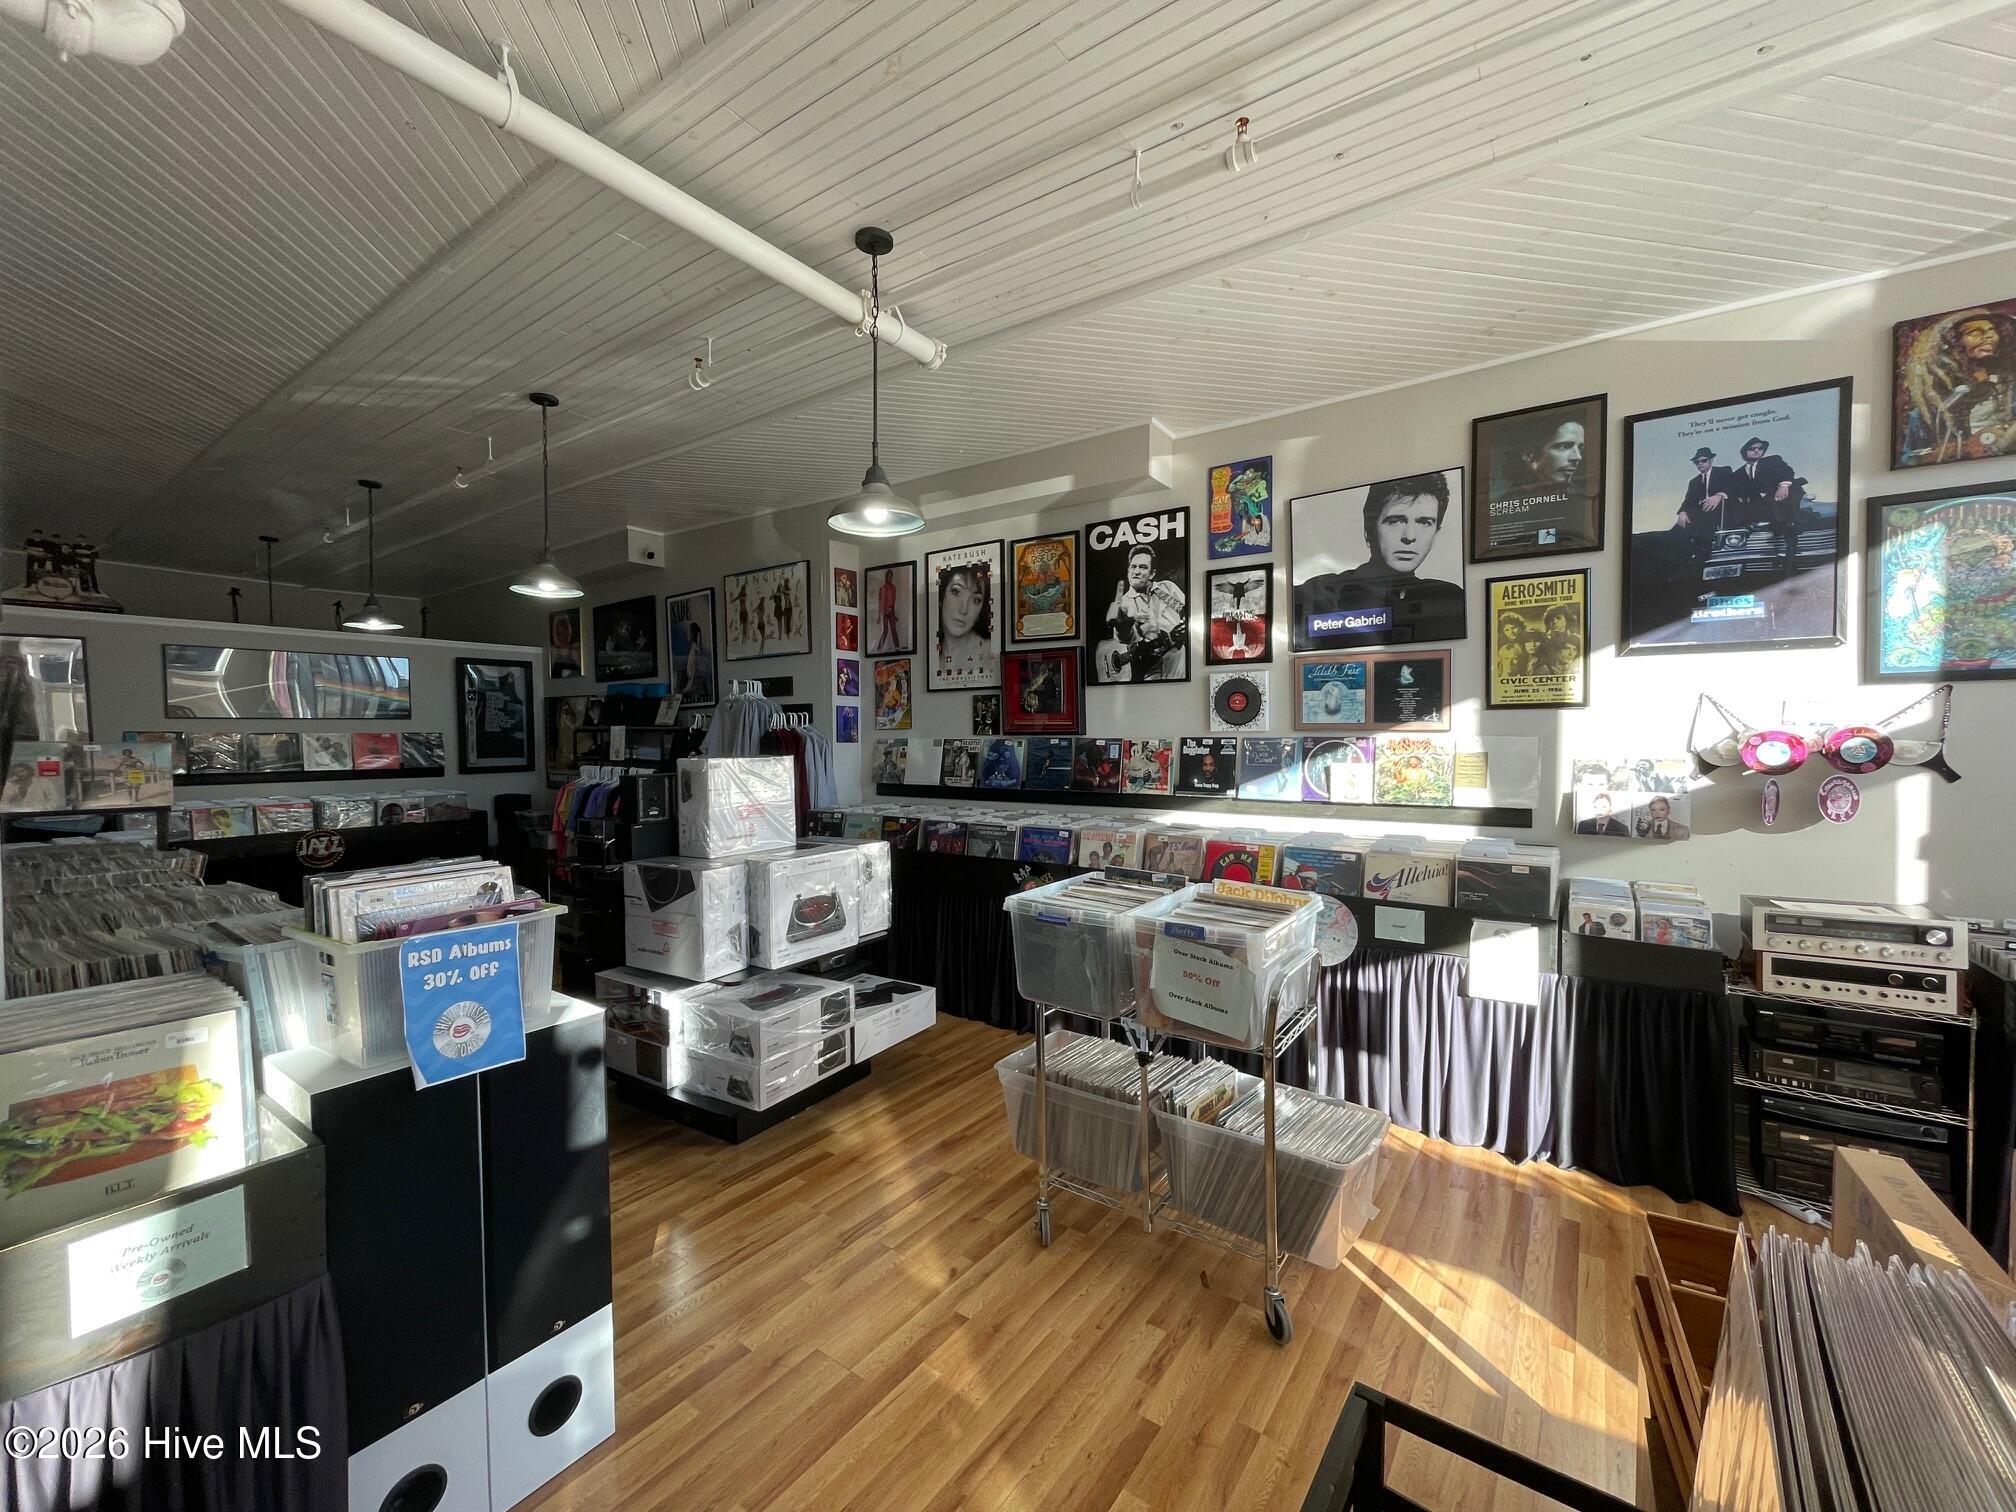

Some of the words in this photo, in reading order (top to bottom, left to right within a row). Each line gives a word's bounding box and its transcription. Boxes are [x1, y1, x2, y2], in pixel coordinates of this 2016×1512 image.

[1676, 428, 1703, 439] They're
[1722, 422, 1750, 431] mission
[1752, 417, 1771, 427] from
[1772, 413, 1792, 423] God.
[1688, 418, 1714, 429] They'll
[1715, 415, 1735, 424] never
[1737, 413, 1749, 422] get
[1489, 499, 1520, 510] CHRIS
[1522, 493, 1569, 506] CORNELL
[1489, 505, 1530, 517] SCREAM
[1089, 511, 1185, 551] CASH
[942, 552, 962, 562] KATE
[963, 549, 987, 559] BUSH
[1502, 579, 1576, 600] AEROSMITH
[1708, 595, 1753, 607] Blues
[1313, 618, 1344, 632] Peter
[1344, 613, 1387, 629] Gabriel
[1500, 676, 1528, 685] CIVIC
[1532, 675, 1577, 684] CENTER
[300, 835, 345, 857] JAZZ
[1012, 864, 1031, 884] RAP
[1215, 882, 1251, 899] Jack
[407, 947, 443, 968] RSD
[448, 937, 513, 961] Albums
[1173, 947, 1189, 958] Over
[1189, 951, 1208, 963] Stock
[1208, 955, 1235, 970] Albums
[423, 968, 464, 991] 30%
[1182, 969, 1203, 985] 50%
[1204, 975, 1222, 988] Off
[1168, 991, 1185, 1002] Over
[1185, 994, 1203, 1007] Stock
[1203, 1000, 1229, 1016] Albums
[121, 1223, 195, 1257] Pre-Owned
[109, 1251, 157, 1274] Weekly
[160, 1230, 211, 1256] Arrivals
